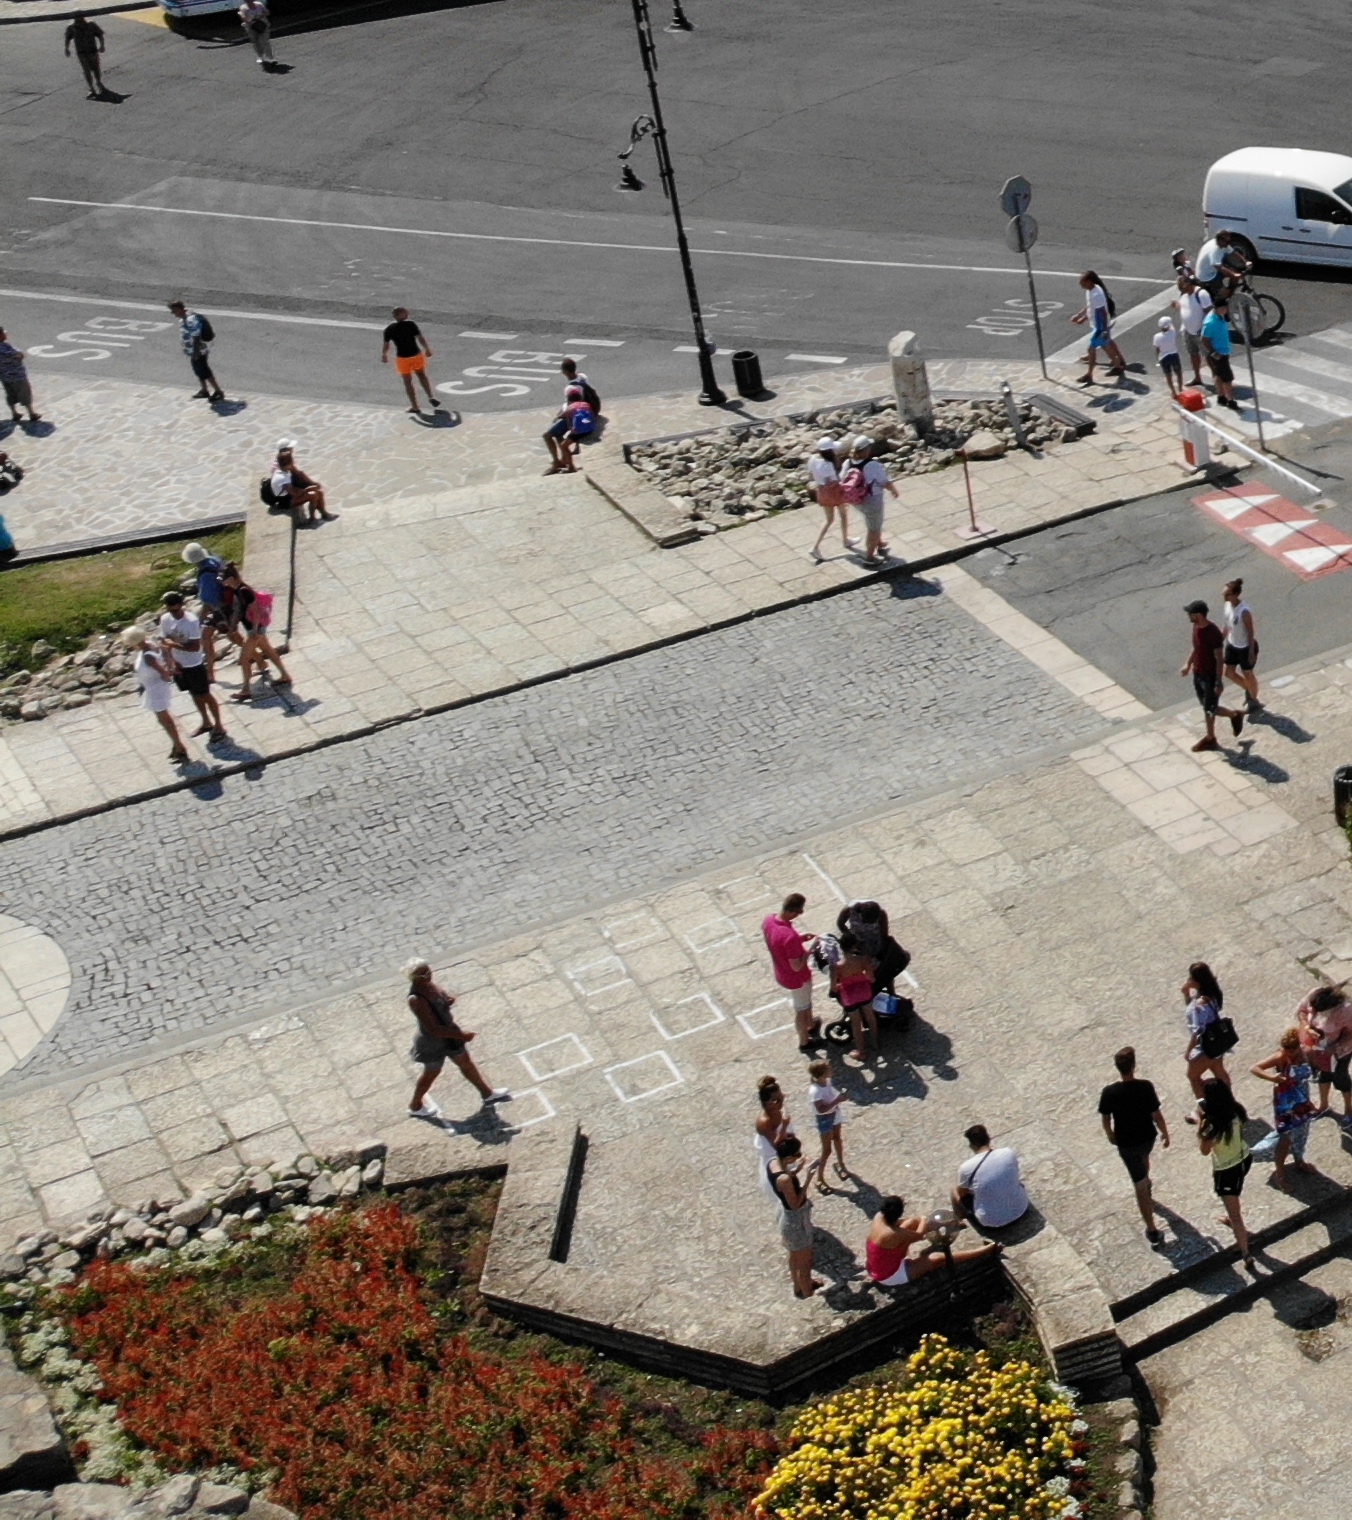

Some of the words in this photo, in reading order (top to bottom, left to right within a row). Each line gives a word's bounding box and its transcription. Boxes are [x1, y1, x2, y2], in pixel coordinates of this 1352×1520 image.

[27, 316, 175, 361] BUS
[965, 298, 1065, 336] STOP
[435, 349, 589, 397] BUS
